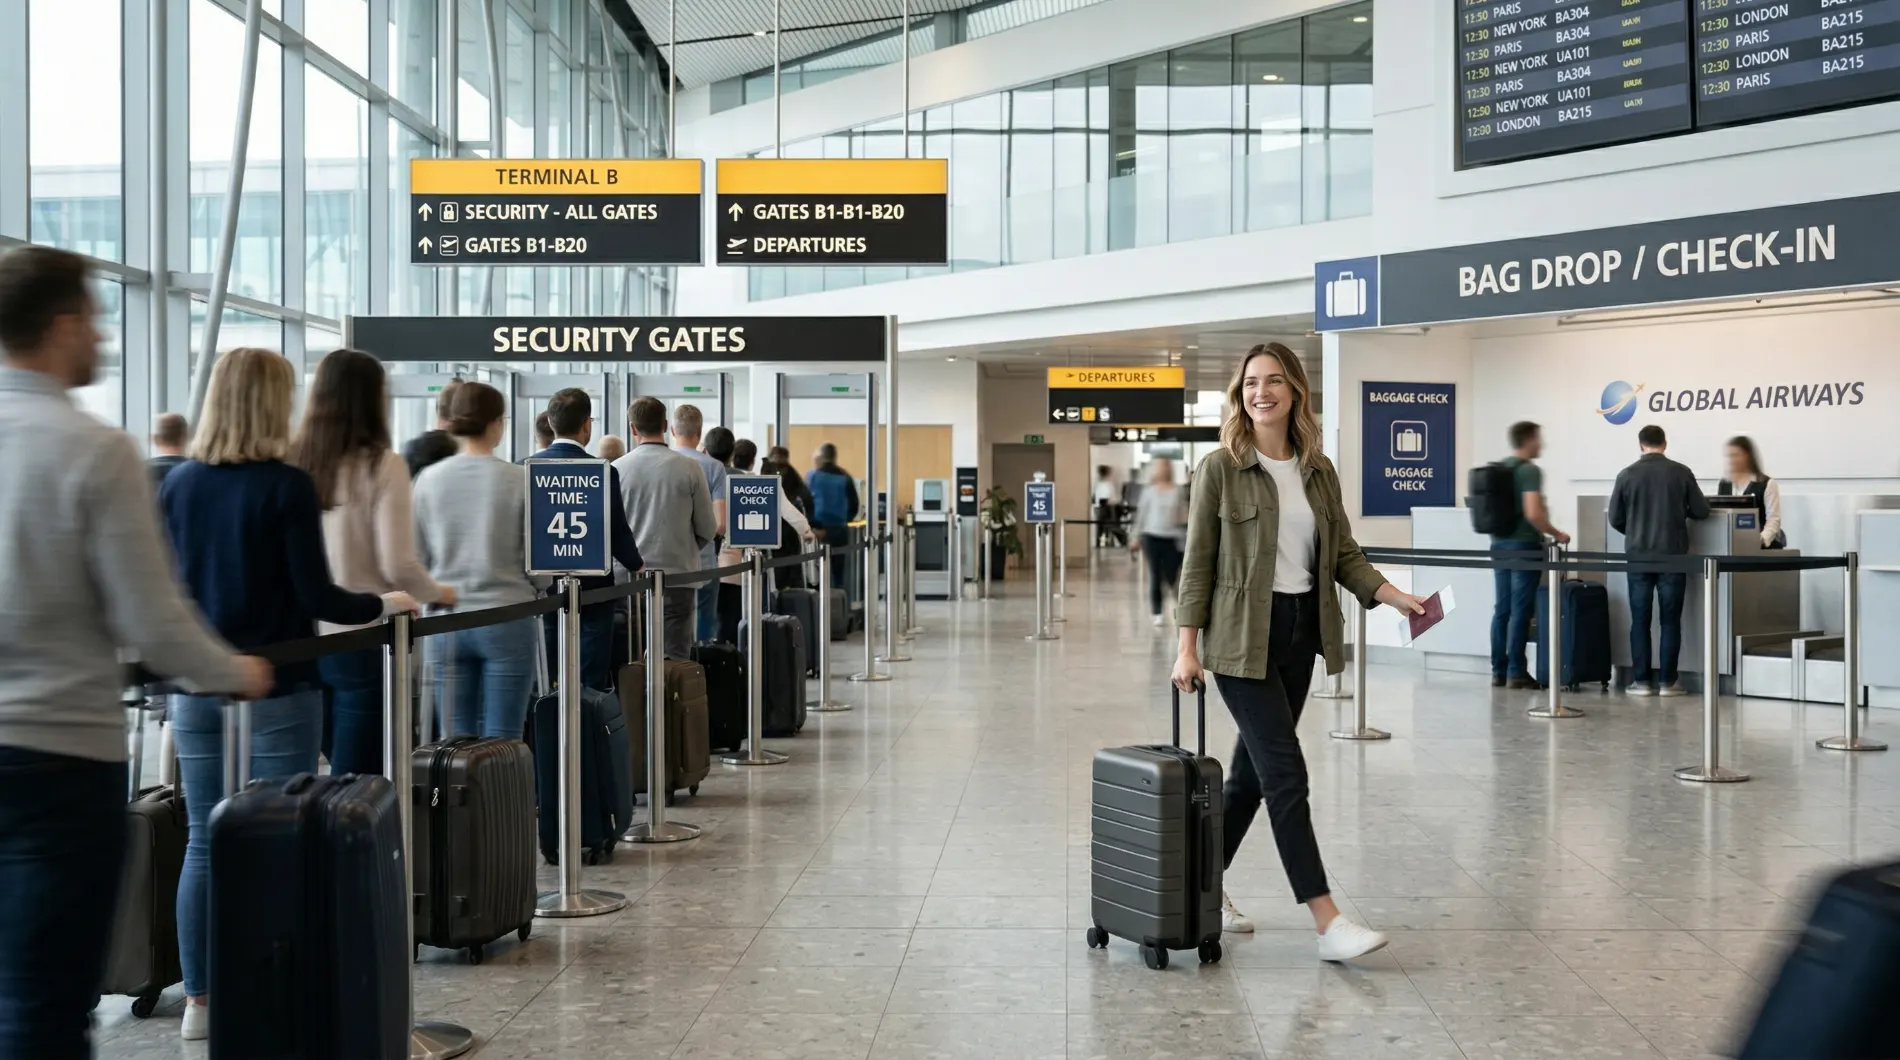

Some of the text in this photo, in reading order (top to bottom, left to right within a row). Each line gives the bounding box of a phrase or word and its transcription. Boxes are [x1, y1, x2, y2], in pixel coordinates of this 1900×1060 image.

[1493, 2, 1521, 18] PARIS
[1701, 4, 1789, 32] 12:30 LONDON
[1494, 22, 1517, 37] NEW
[1519, 15, 1547, 31] YORK
[1555, 6, 1590, 24] BA304
[1702, 10, 1863, 53] 12:30 PARIS BA215
[1494, 40, 1522, 56] PARIS
[1556, 25, 1590, 43] BA304
[1495, 60, 1518, 75] NEW
[1520, 54, 1548, 70] YORK
[1556, 46, 1590, 63] UA101
[1702, 32, 1864, 74] 12:30 LONDON BA215
[1466, 65, 1591, 99] 12:30 PARIS BA304
[1703, 54, 1865, 96] 12:30 PARIS BA215
[1496, 99, 1519, 113] NEW
[1521, 93, 1549, 109] YORK
[1557, 85, 1591, 102] UA101
[1496, 115, 1541, 133] LONDON
[1558, 105, 1592, 122] BA215
[496, 169, 618, 185] TERMINAL B
[465, 204, 549, 220] SECURITY
[565, 204, 597, 220] ALL
[602, 204, 658, 220] GATES
[753, 204, 905, 220] GATES B1-B1-B20
[465, 237, 587, 254] GATES B1-B20
[753, 237, 867, 254] DEPARTURES
[1458, 260, 1521, 298] BAG
[1532, 250, 1622, 289] DROP
[1656, 225, 1836, 276] CHECK-IN
[493, 327, 746, 354] SECURITY GATES
[1079, 372, 1155, 383] DEPARTURES
[1369, 392, 1449, 404] BAGGAGE CHECK
[1648, 382, 1865, 413] GLOBAL AIRWAYS
[1385, 467, 1434, 479] BAGGAGE
[536, 476, 600, 488] WAITING
[1392, 480, 1426, 491] CHECK
[548, 492, 588, 504] TIME:
[734, 486, 774, 496] BAGGAGE
[740, 496, 768, 505] CHECK
[1033, 500, 1046, 510] 45
[547, 511, 588, 539] 45
[553, 544, 583, 556] MIN
